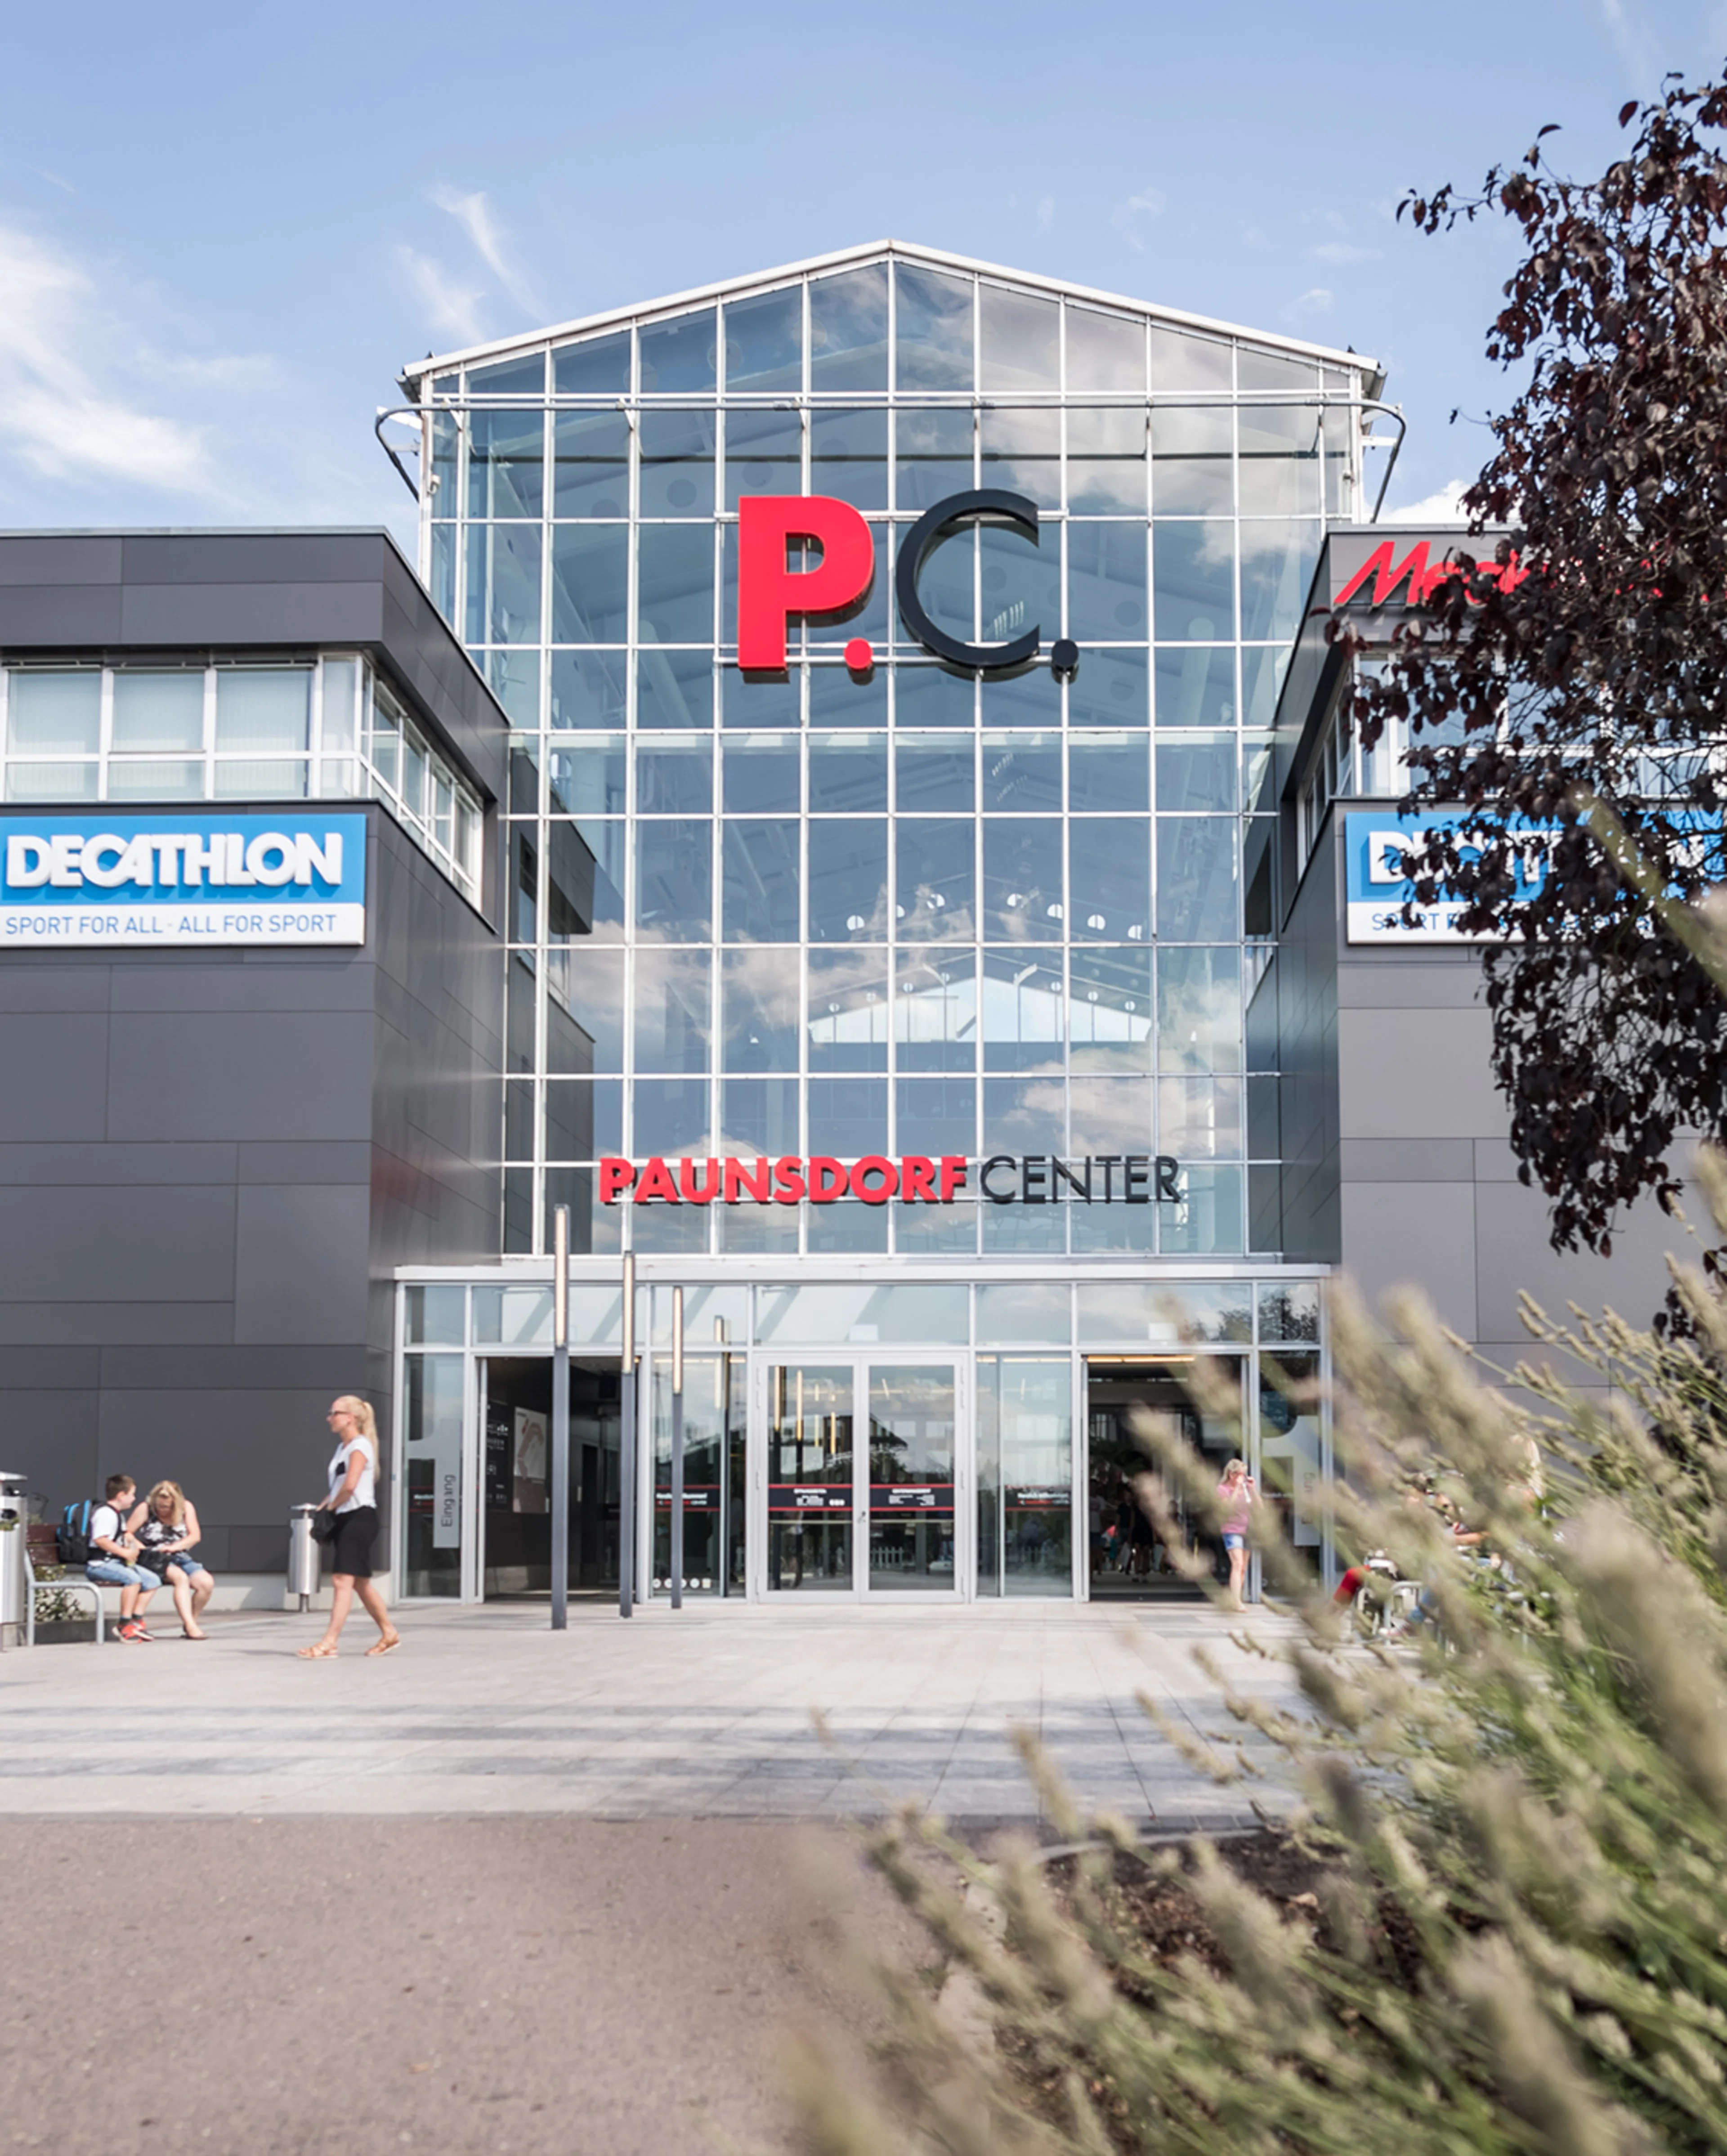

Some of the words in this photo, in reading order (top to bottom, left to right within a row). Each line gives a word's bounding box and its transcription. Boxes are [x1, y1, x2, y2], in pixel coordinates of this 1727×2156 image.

[6, 832, 343, 888] DECATHLON
[5, 916, 73, 935] SPORT
[79, 916, 119, 934] FOR
[124, 916, 163, 933] ALL
[178, 915, 217, 933] ALL
[224, 915, 264, 932] FOR
[268, 914, 337, 932] SPORT
[599, 1156, 967, 1204] PAUNSDORF
[980, 1155, 1182, 1204] CENTER
[440, 1474, 457, 1528] Eingang
